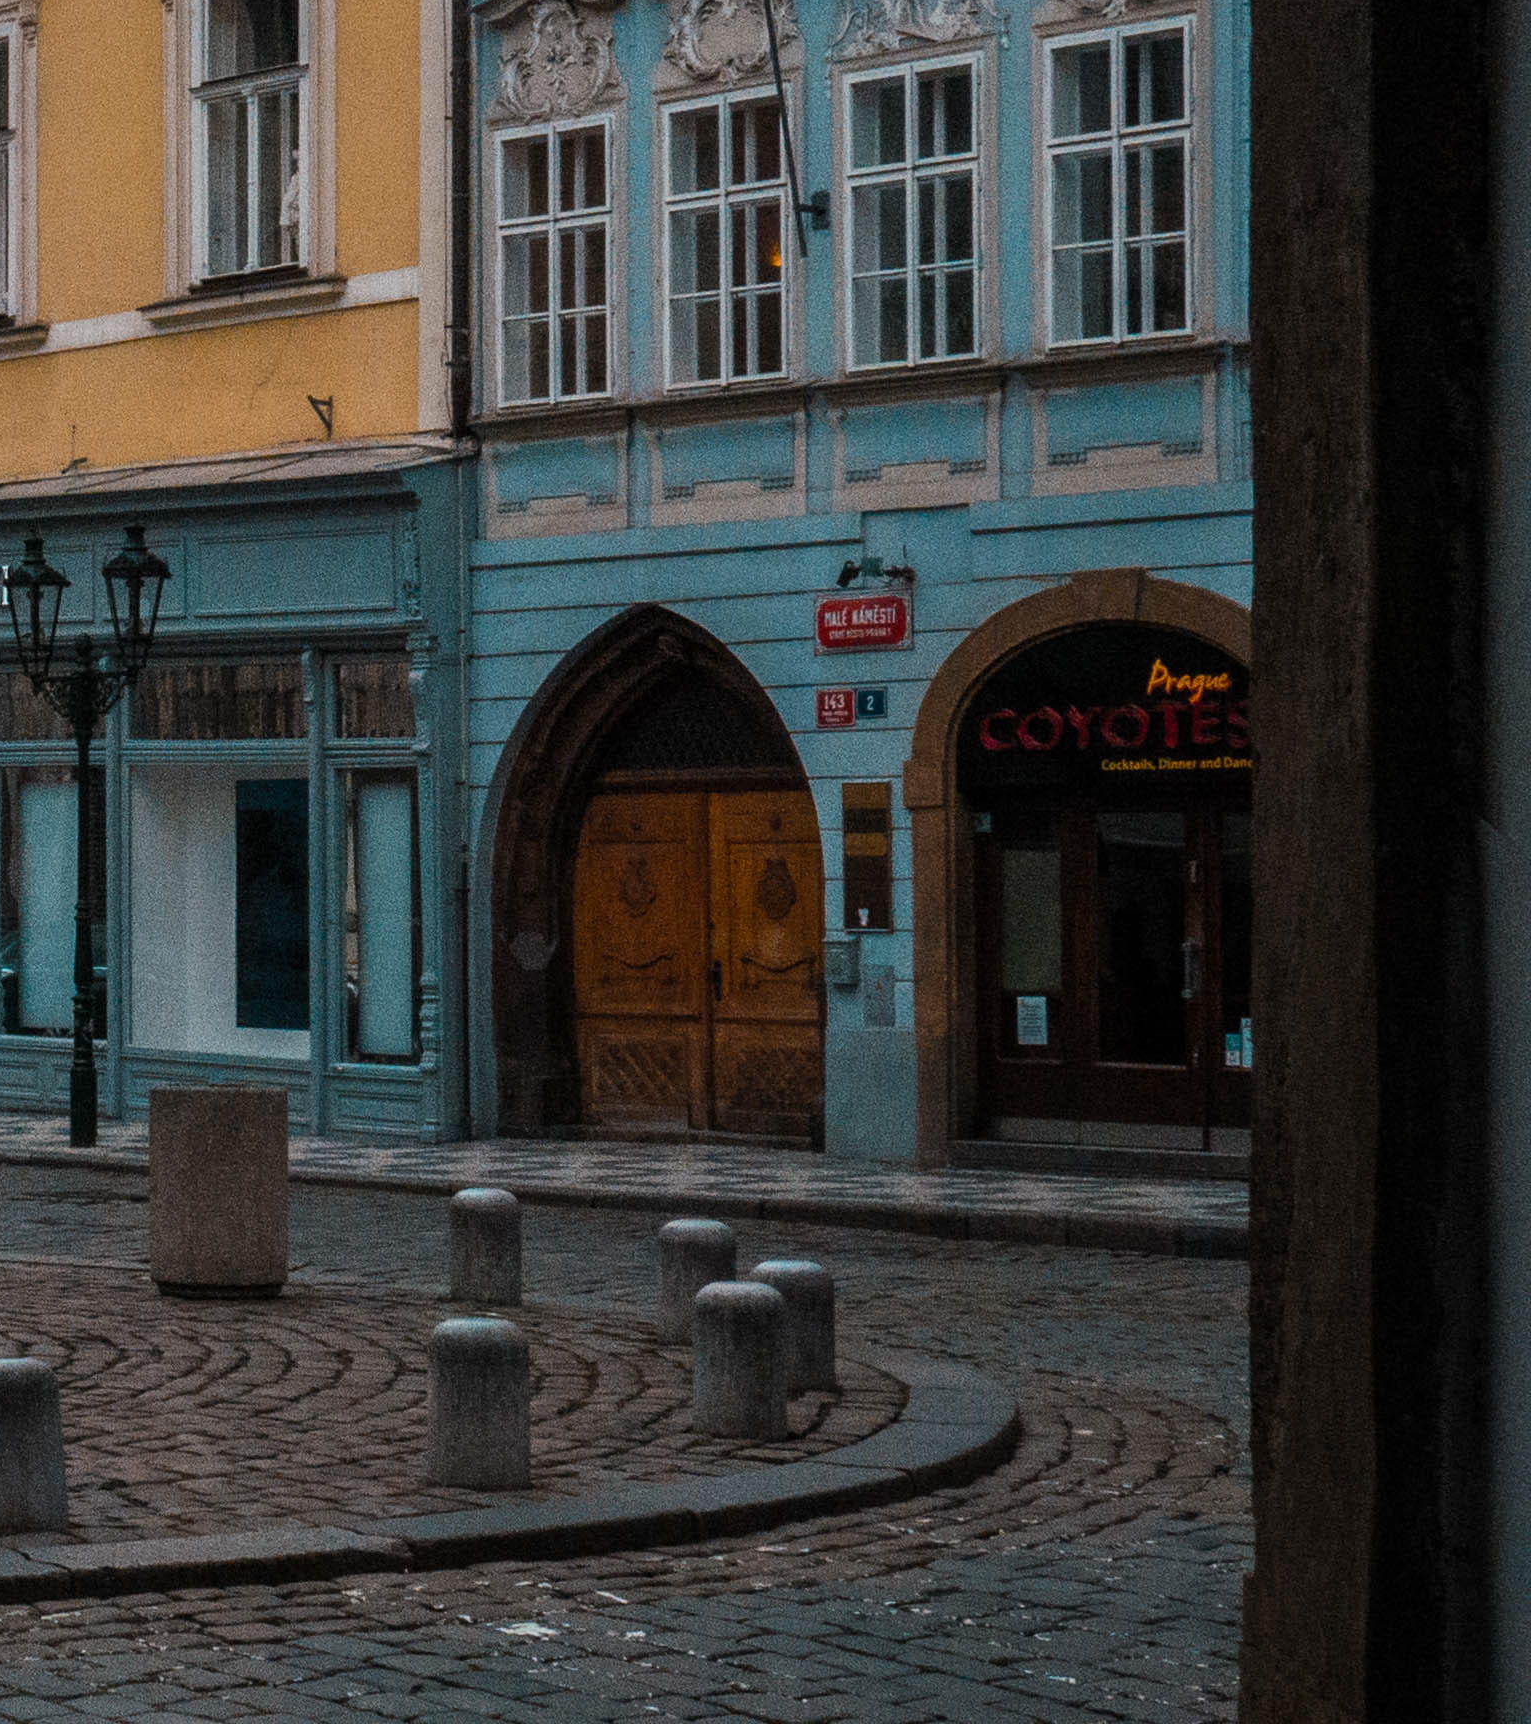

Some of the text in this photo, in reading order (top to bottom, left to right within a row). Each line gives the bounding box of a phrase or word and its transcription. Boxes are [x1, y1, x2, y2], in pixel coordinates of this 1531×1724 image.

[824, 603, 897, 627] MALÉ NÁMĚSTÍ
[1147, 658, 1233, 704] Prague
[824, 694, 845, 710] 143
[866, 695, 875, 711] 2
[979, 701, 1248, 751] COYOTES
[1100, 758, 1156, 771] Cocktails,
[1159, 758, 1197, 770] Dinner
[1199, 756, 1221, 769] and
